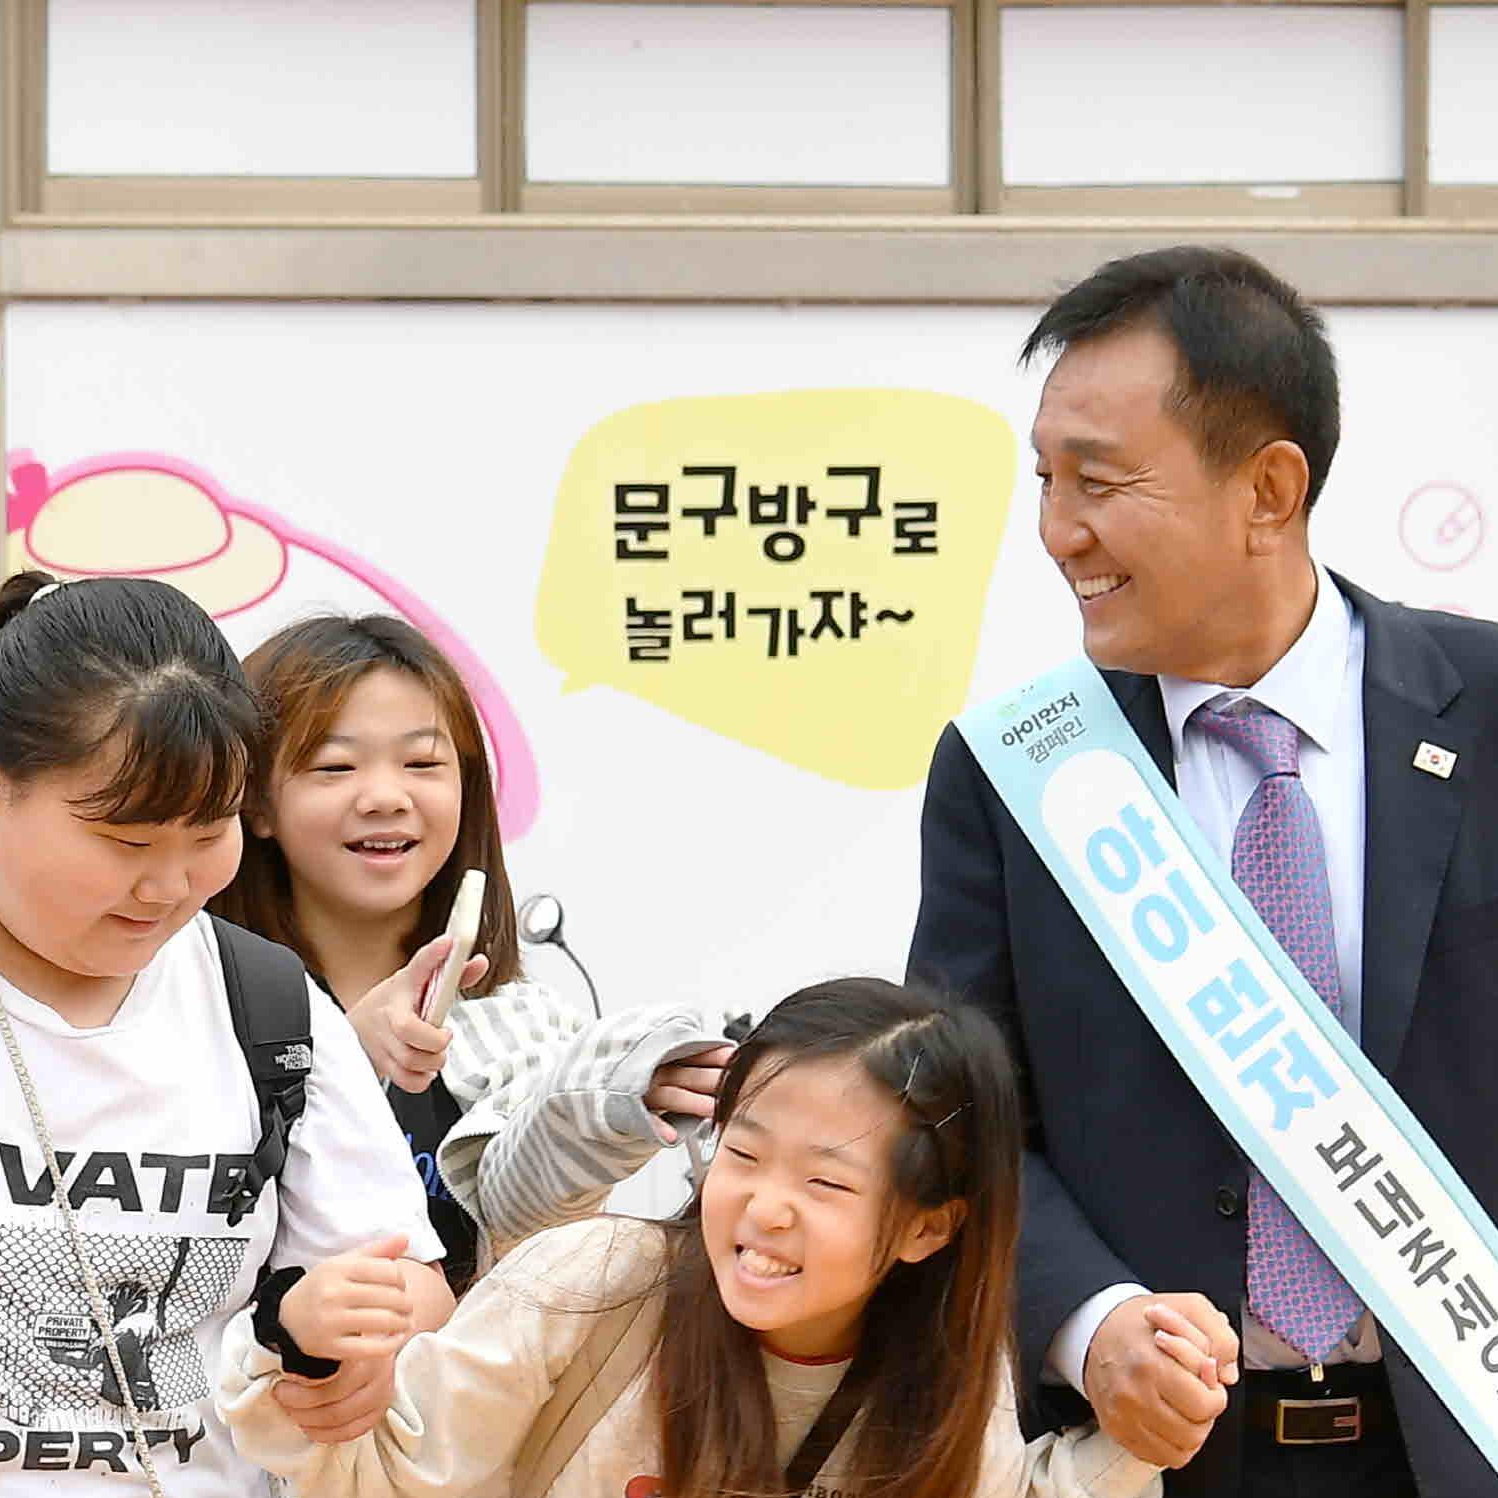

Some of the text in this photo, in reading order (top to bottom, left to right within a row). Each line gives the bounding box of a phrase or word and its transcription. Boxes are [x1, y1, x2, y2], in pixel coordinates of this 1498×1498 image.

[614, 465, 940, 563] 문구방구로
[1000, 690, 1082, 750] 아이먼저
[1024, 714, 1088, 766] 캠페인
[1083, 801, 1216, 964] 아이
[1185, 964, 1343, 1134] 먼저
[38, 1326, 88, 1338] PROPERTY
[45, 1316, 84, 1328] PRIVATE
